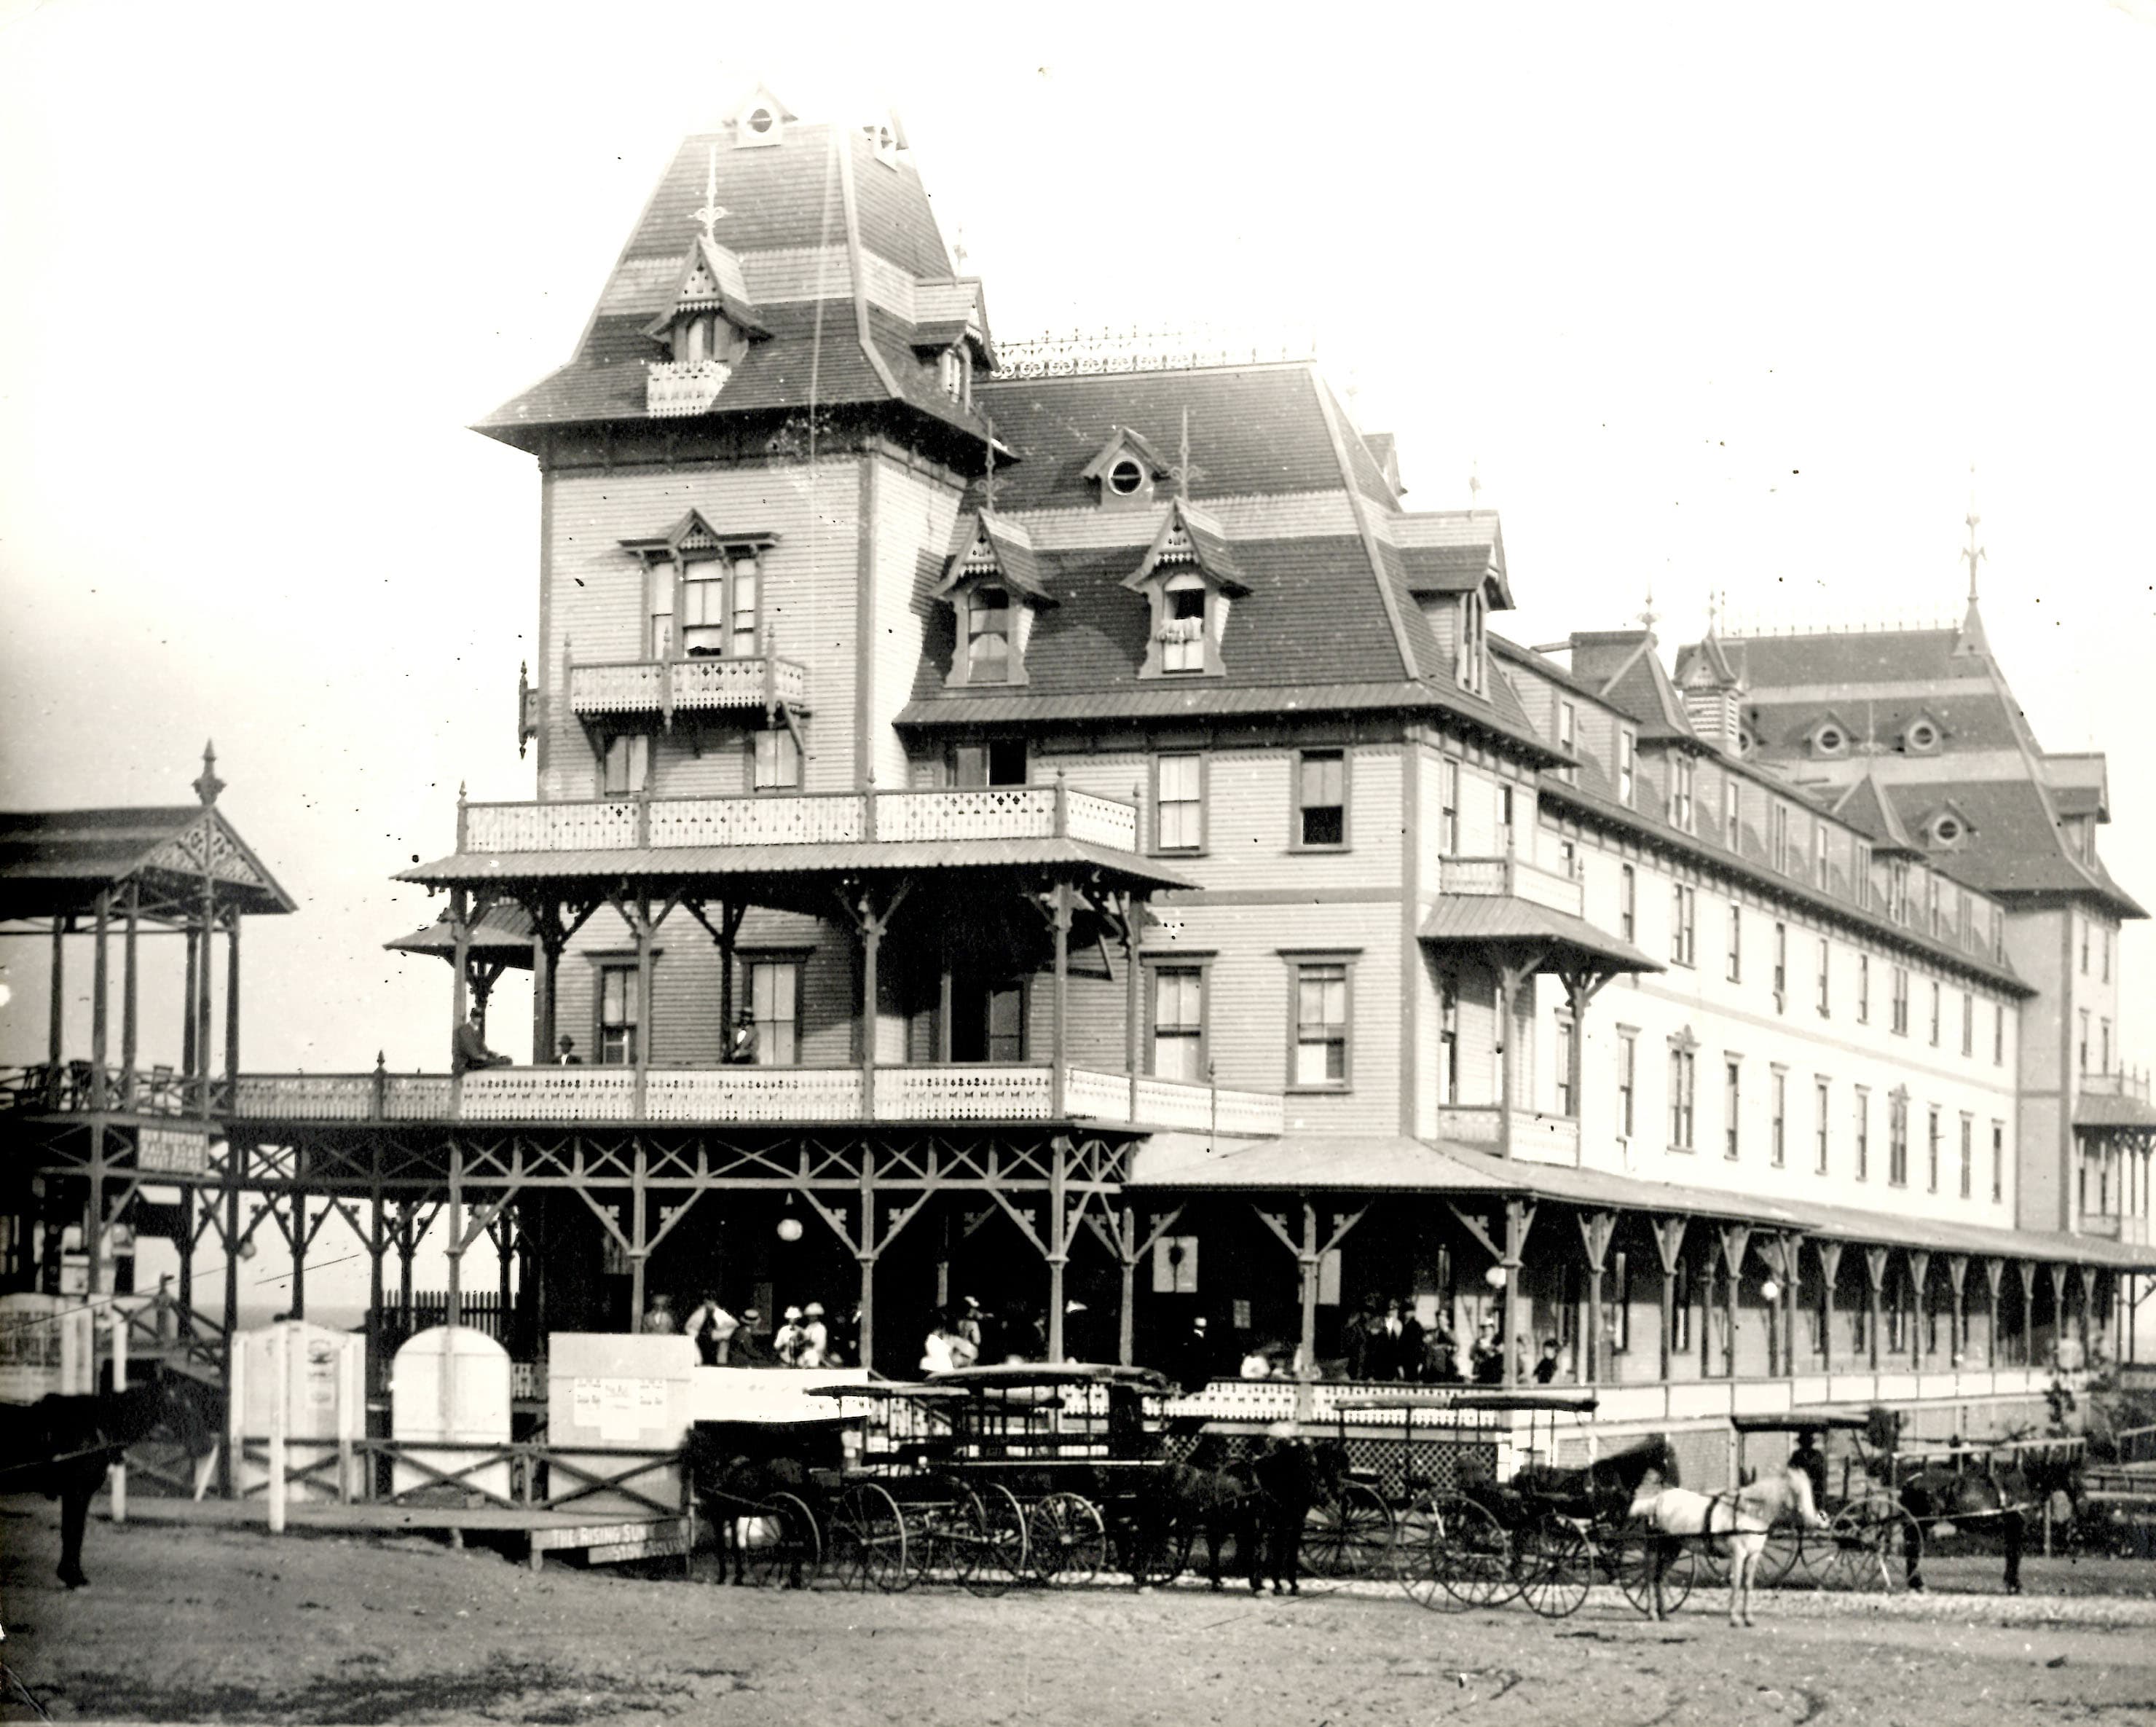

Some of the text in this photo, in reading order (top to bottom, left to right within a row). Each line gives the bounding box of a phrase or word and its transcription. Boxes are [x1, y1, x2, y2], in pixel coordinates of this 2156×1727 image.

[552, 1524, 648, 1549] THE RISING SUN
[613, 1541, 648, 1561] STOV
